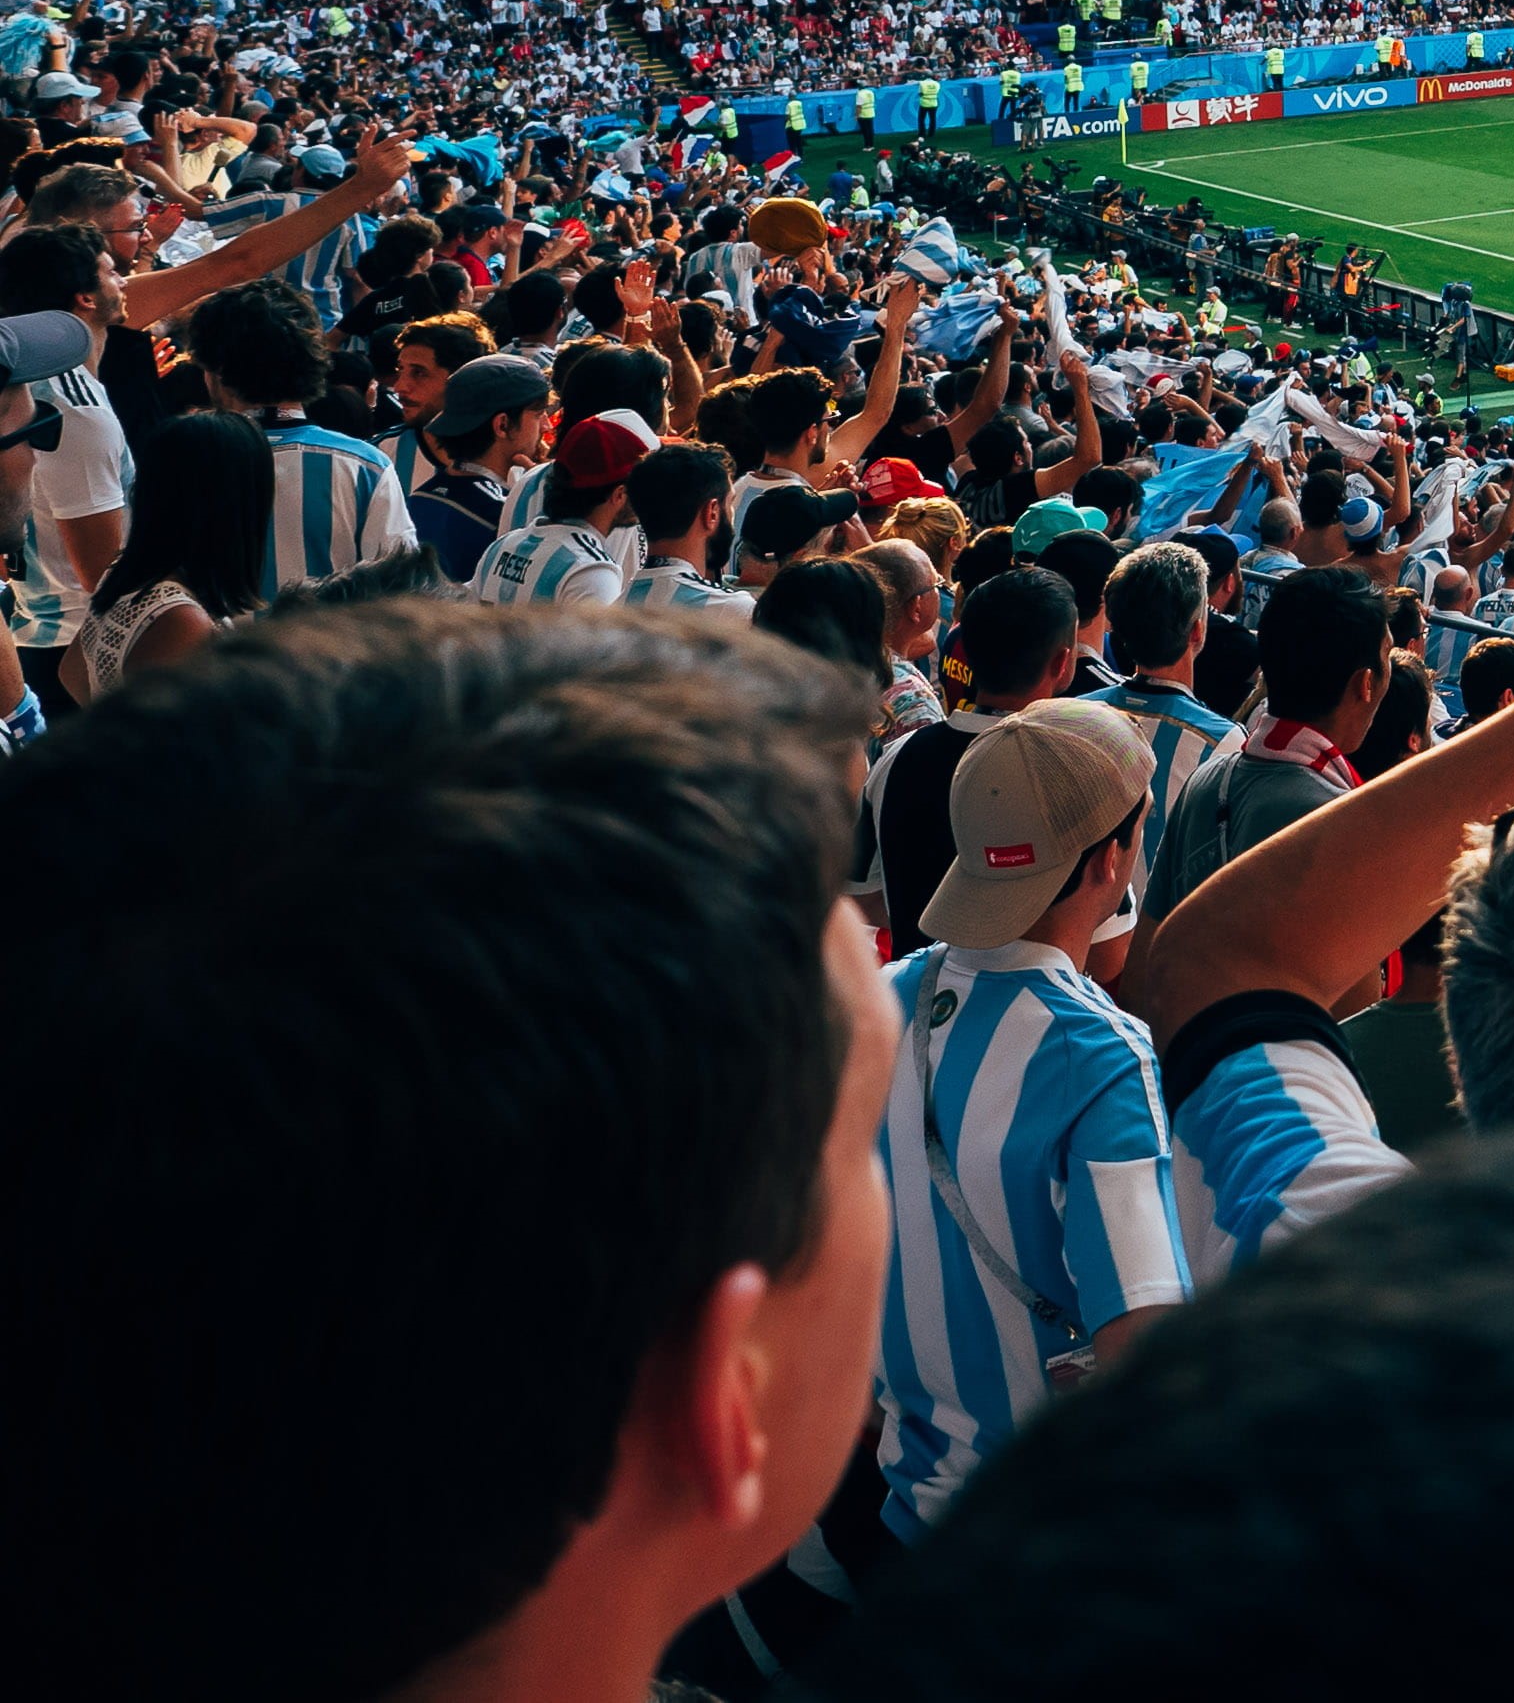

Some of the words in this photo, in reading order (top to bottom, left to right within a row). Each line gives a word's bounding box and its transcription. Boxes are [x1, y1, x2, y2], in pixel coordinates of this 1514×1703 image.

[1447, 76, 1512, 93] McDonald's
[1206, 93, 1260, 125] 蒙牛
[942, 654, 973, 687] MESSI
